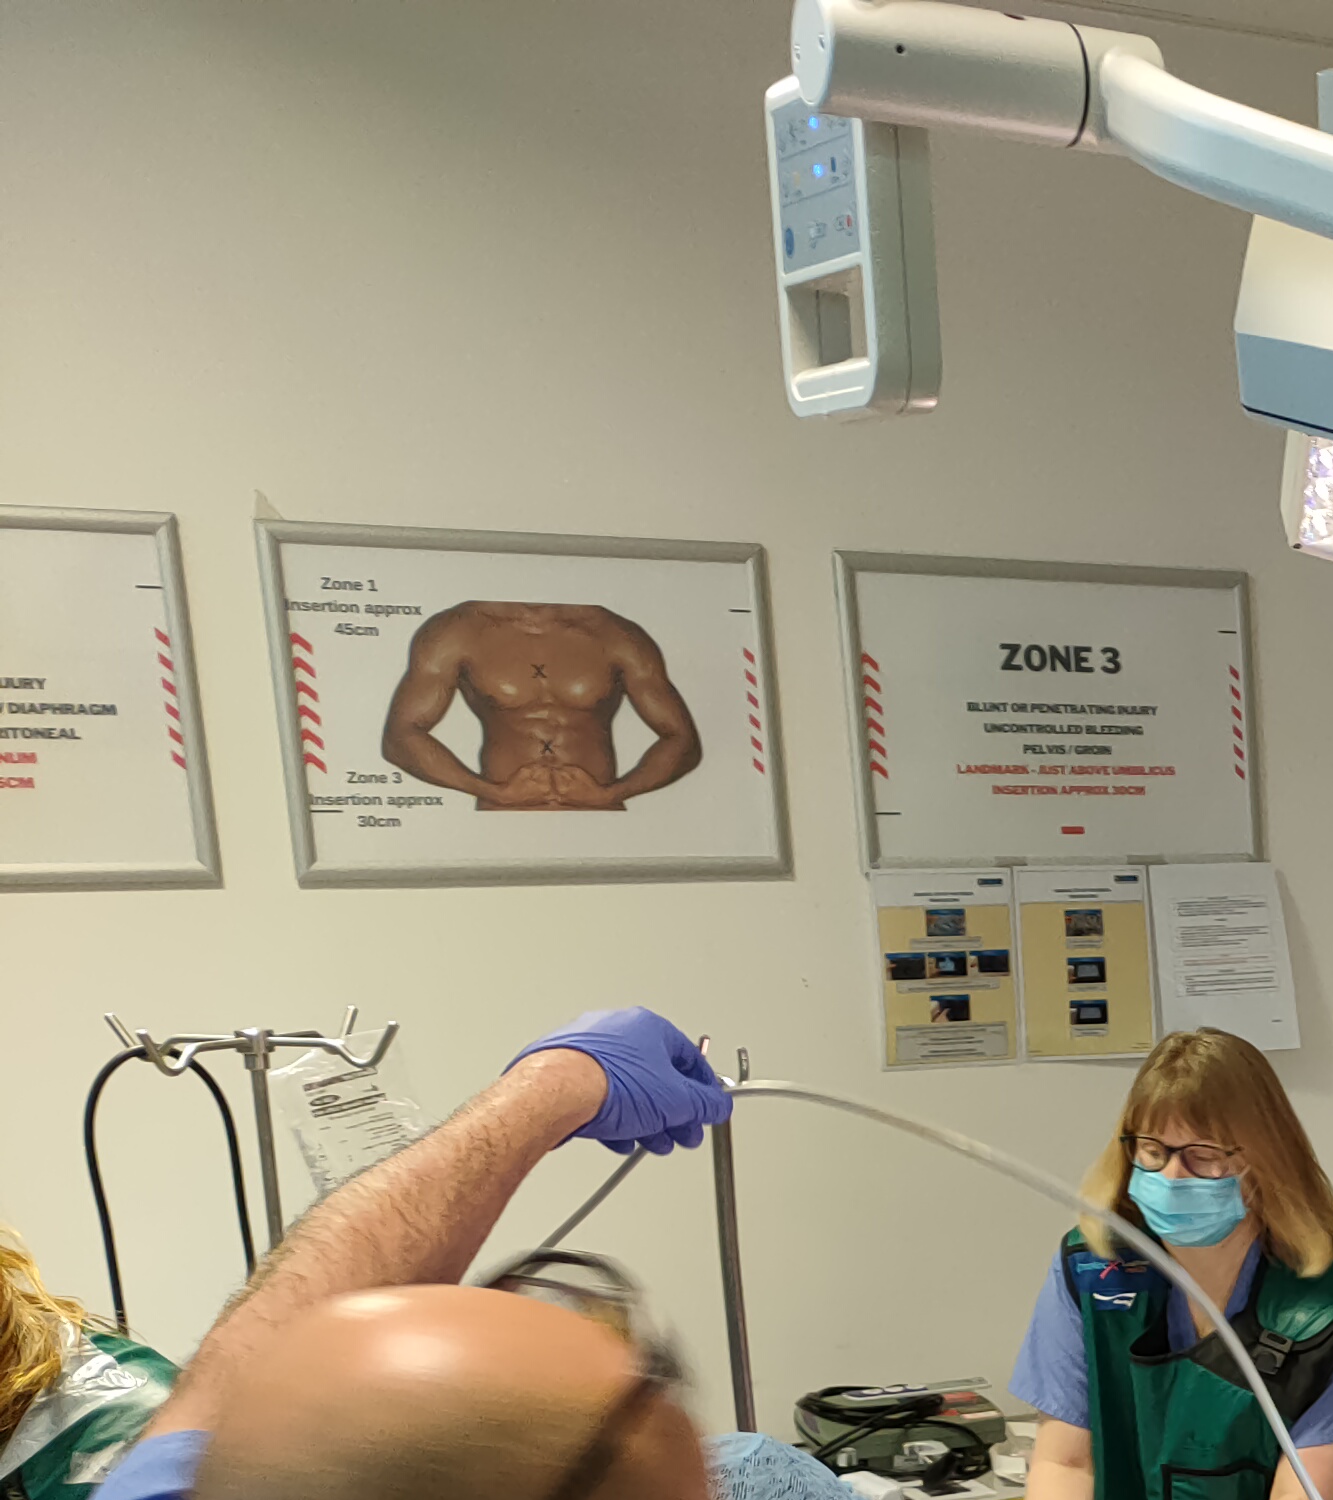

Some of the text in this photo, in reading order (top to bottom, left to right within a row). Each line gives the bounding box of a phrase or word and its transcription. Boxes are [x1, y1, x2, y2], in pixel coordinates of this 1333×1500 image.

[320, 577, 378, 592] Zone 1
[285, 599, 423, 617] Insertion approx
[334, 622, 379, 636] 45cm
[999, 643, 1122, 674] ZONE 3
[0, 677, 47, 690] JURY
[7, 702, 118, 716] DIAPHRAGM
[966, 702, 1008, 713] BLUNT
[1010, 703, 1029, 714] OR
[1030, 703, 1115, 716] PENETRATING
[984, 723, 1145, 736] UNCONTROLLED BLEEDING
[1022, 744, 1066, 755] PELVIS
[1074, 745, 1113, 756] GROIN
[956, 763, 1030, 775] LANDMARK
[1070, 765, 1111, 776] ABOVE
[1112, 765, 1177, 777] UMBILICUS
[346, 771, 403, 785] Zone 3
[991, 784, 1058, 796] INSERTION
[309, 793, 443, 809] Insertion approx
[357, 815, 402, 828] 30cm
